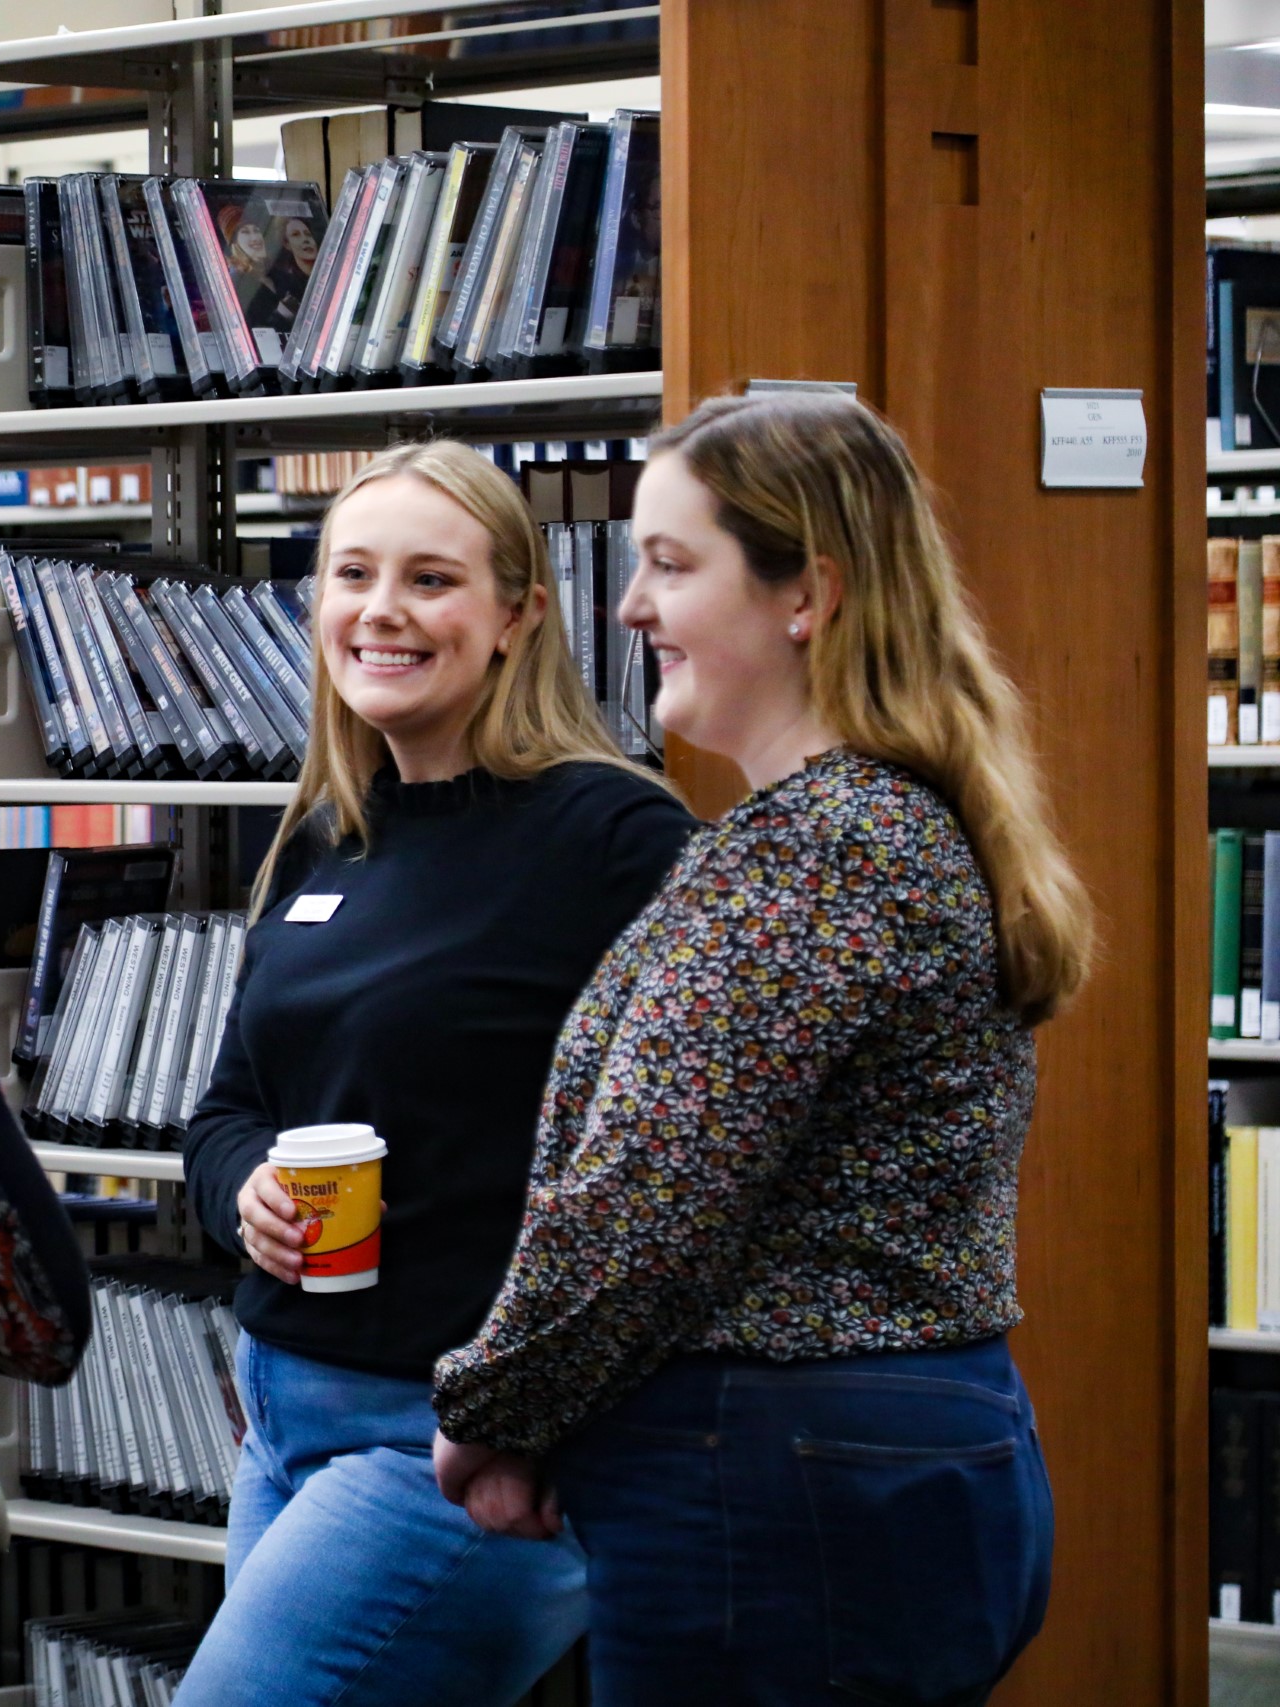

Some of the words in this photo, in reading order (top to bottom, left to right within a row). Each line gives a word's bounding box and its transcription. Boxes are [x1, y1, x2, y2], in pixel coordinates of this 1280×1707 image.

[28, 201, 36, 261] STARGATE
[468, 244, 483, 273] TWO
[455, 273, 474, 313] CITIES
[3, 570, 25, 629] TOWN
[105, 592, 118, 614] TRIAL
[117, 616, 126, 626] BY
[122, 627, 136, 646] JURY
[32, 603, 45, 627] TOWN
[39, 626, 55, 659] WITHOUT
[49, 659, 61, 679] PITY
[152, 644, 165, 664] TRUE
[161, 662, 182, 695] BELIEVER
[179, 628, 193, 646] TRUE
[190, 645, 218, 689] CONFESSIONS
[212, 644, 233, 674] TRUE
[229, 672, 251, 701] GRIT
[42, 928, 48, 940] OF
[39, 942, 47, 958] THE
[130, 945, 139, 970] WEST
[161, 945, 170, 970] WEST
[179, 948, 188, 973] WEST
[206, 941, 215, 967] WEST
[34, 959, 43, 986] ROSES
[124, 973, 133, 996] WING
[155, 973, 163, 996] WING
[201, 969, 210, 994] WING
[223, 973, 231, 996] WING
[174, 976, 183, 1000] WING
[291, 1180, 338, 1196] Biscuit
[102, 1306, 110, 1331] WEST
[135, 1314, 145, 1338] WEST
[142, 1342, 151, 1366] WING
